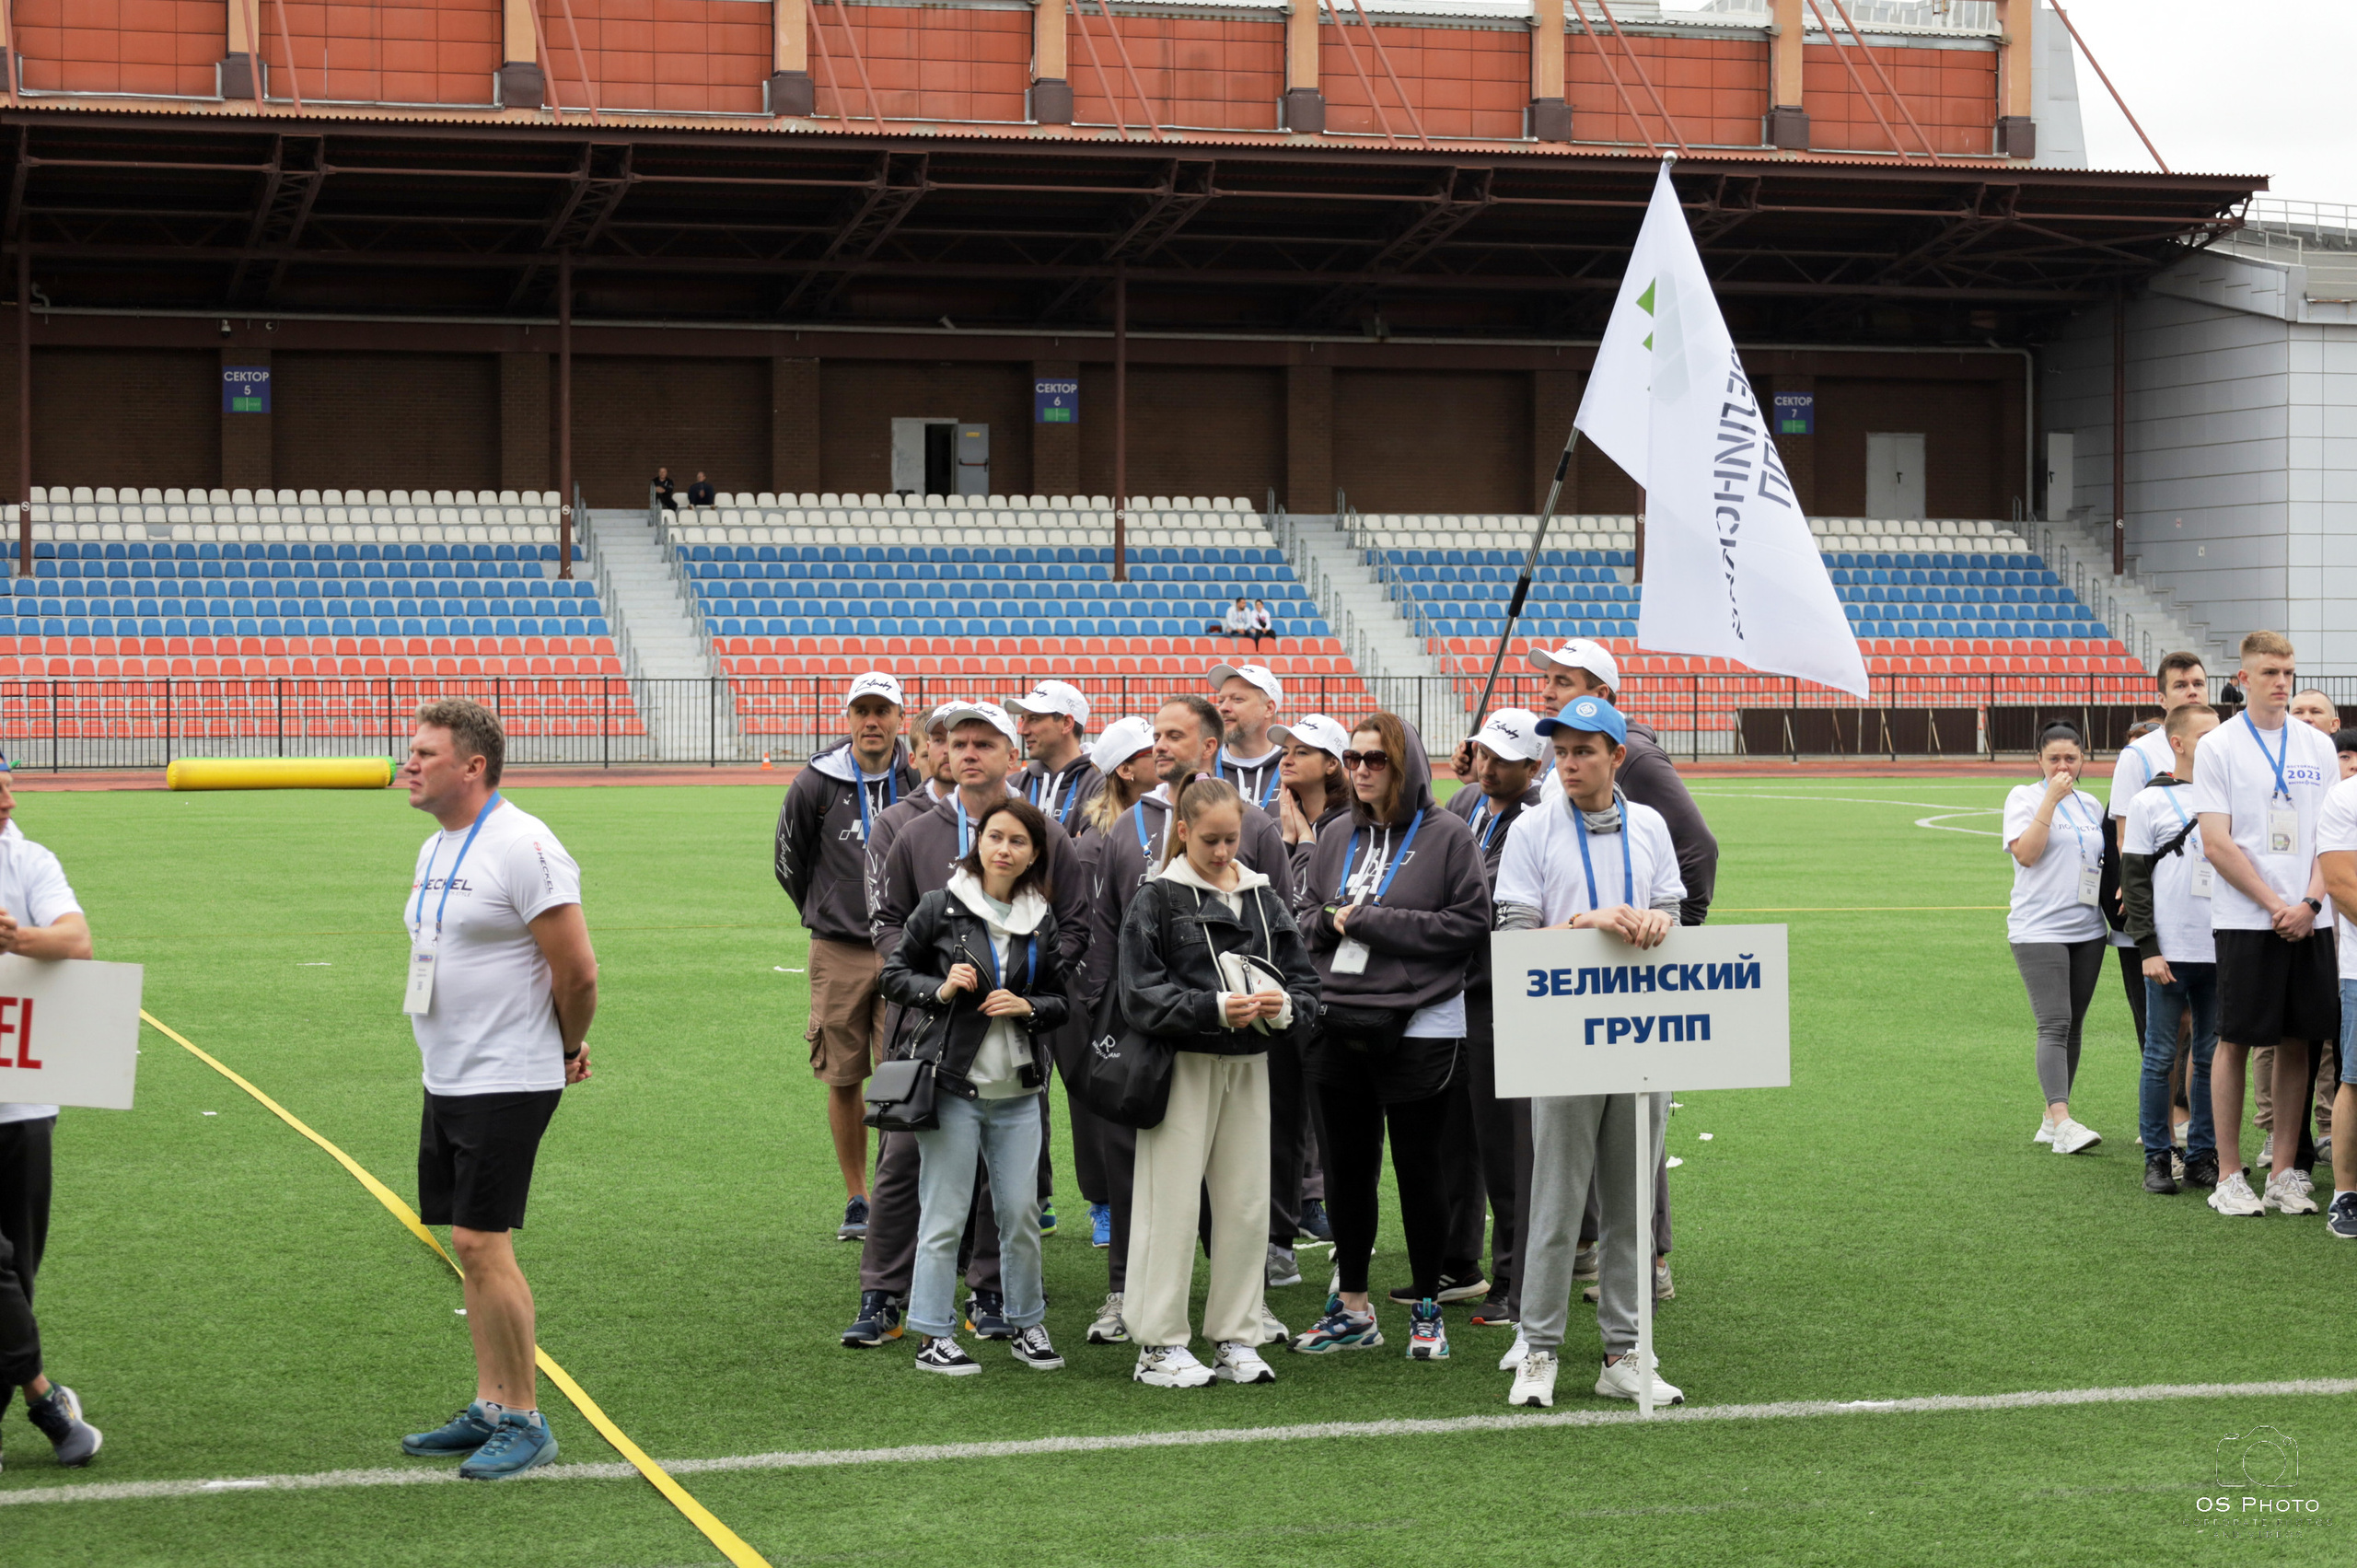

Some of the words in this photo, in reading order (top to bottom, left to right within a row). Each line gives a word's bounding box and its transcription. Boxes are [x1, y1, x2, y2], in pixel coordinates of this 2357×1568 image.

[224, 371, 270, 382] СЕКТОР
[244, 385, 251, 395] 5
[1036, 383, 1078, 393] СЕКТОР
[1053, 396, 1061, 406] 6
[1774, 396, 1813, 406] СЕКТОР
[1791, 409, 1797, 418] 7
[2287, 770, 2320, 781] 2023
[537, 852, 554, 894] HECKEL
[1526, 953, 1760, 997] ЗЕЛИНСКИЙ
[1585, 1014, 1711, 1045] ГРУПП
